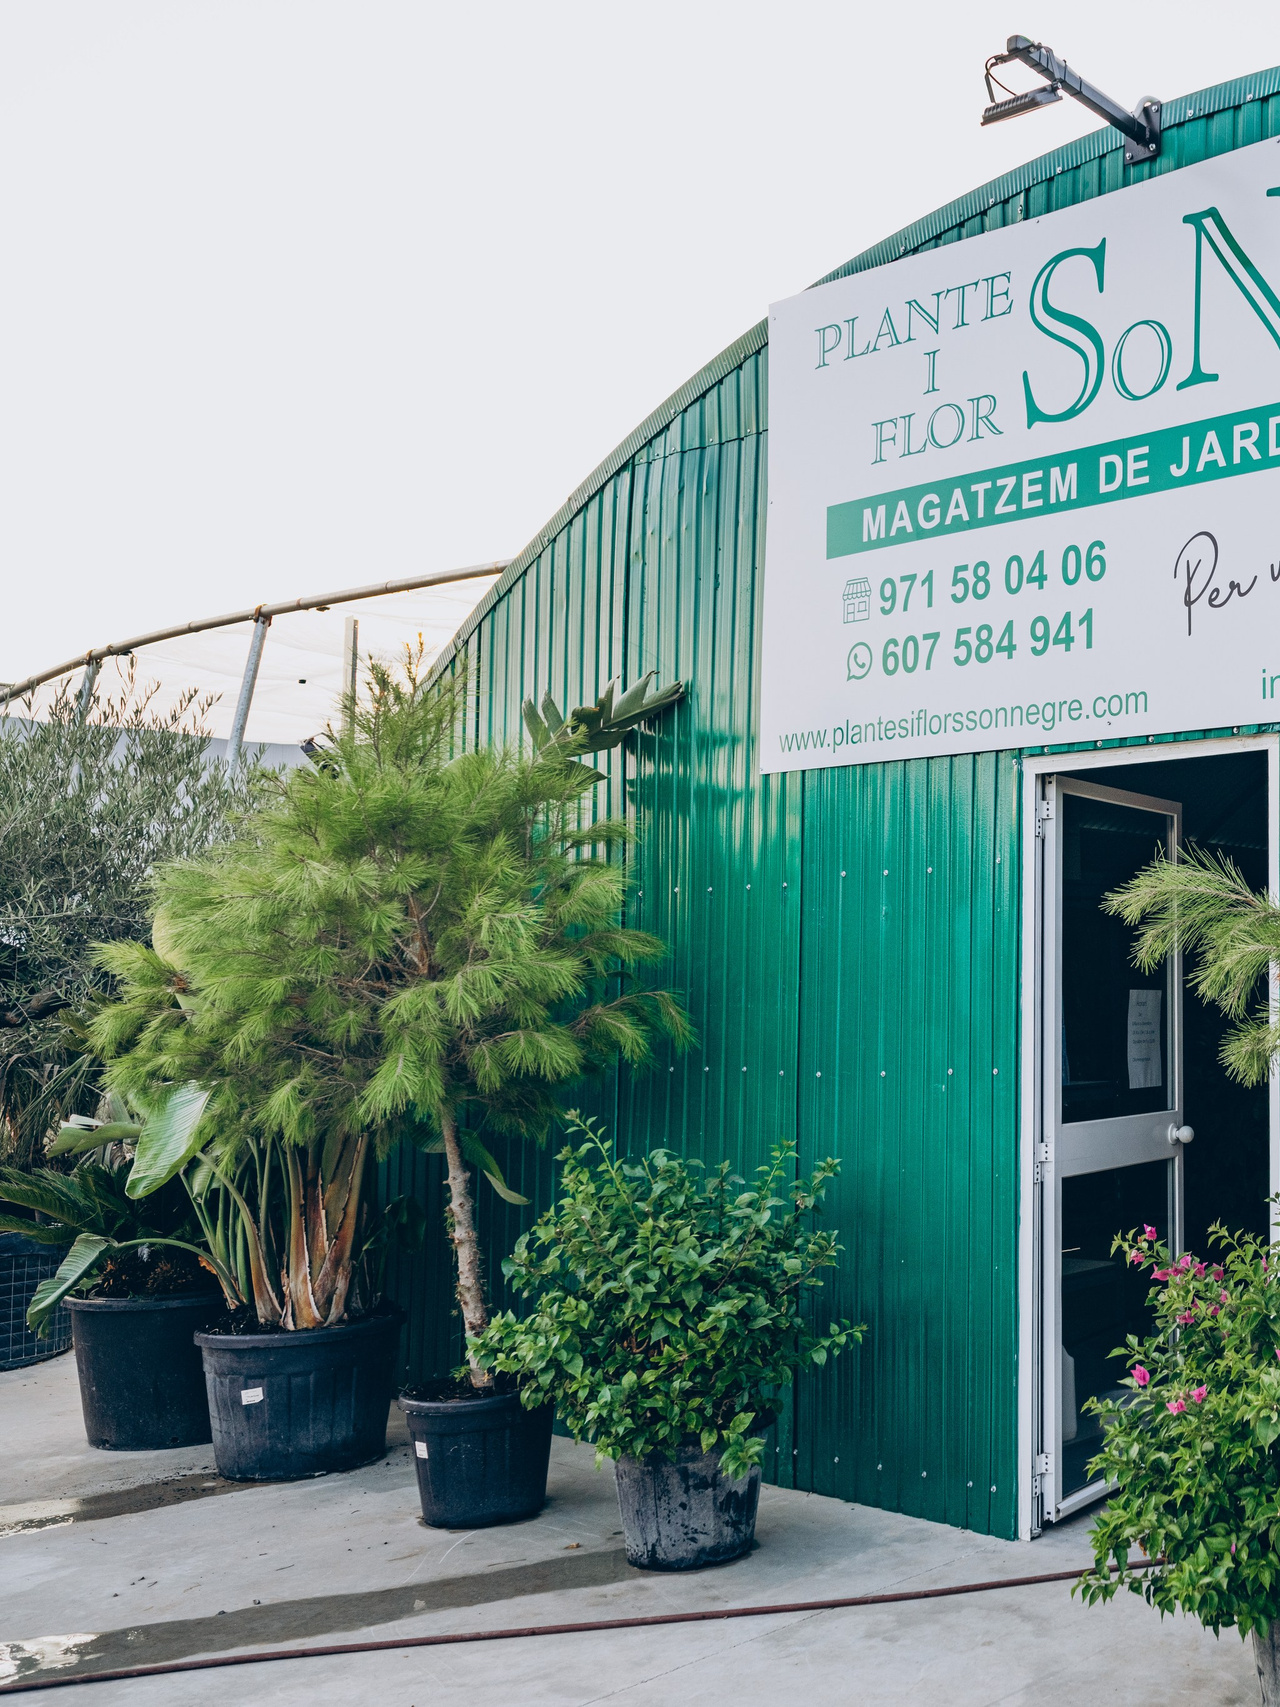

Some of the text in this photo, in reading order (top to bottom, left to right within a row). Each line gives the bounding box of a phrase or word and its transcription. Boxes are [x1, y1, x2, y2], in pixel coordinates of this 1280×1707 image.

[815, 271, 1014, 370] PLANTE
[923, 349, 941, 396] I
[871, 394, 1005, 466] FLOR
[862, 462, 1079, 543] MAGATZEM
[1099, 445, 1151, 494] DE
[879, 540, 1107, 616] 971 58 04 06
[1173, 531, 1258, 636] Per
[881, 607, 1094, 677] 607 584 941
[778, 690, 1149, 753] www.plantesiflorssonnegre.com
